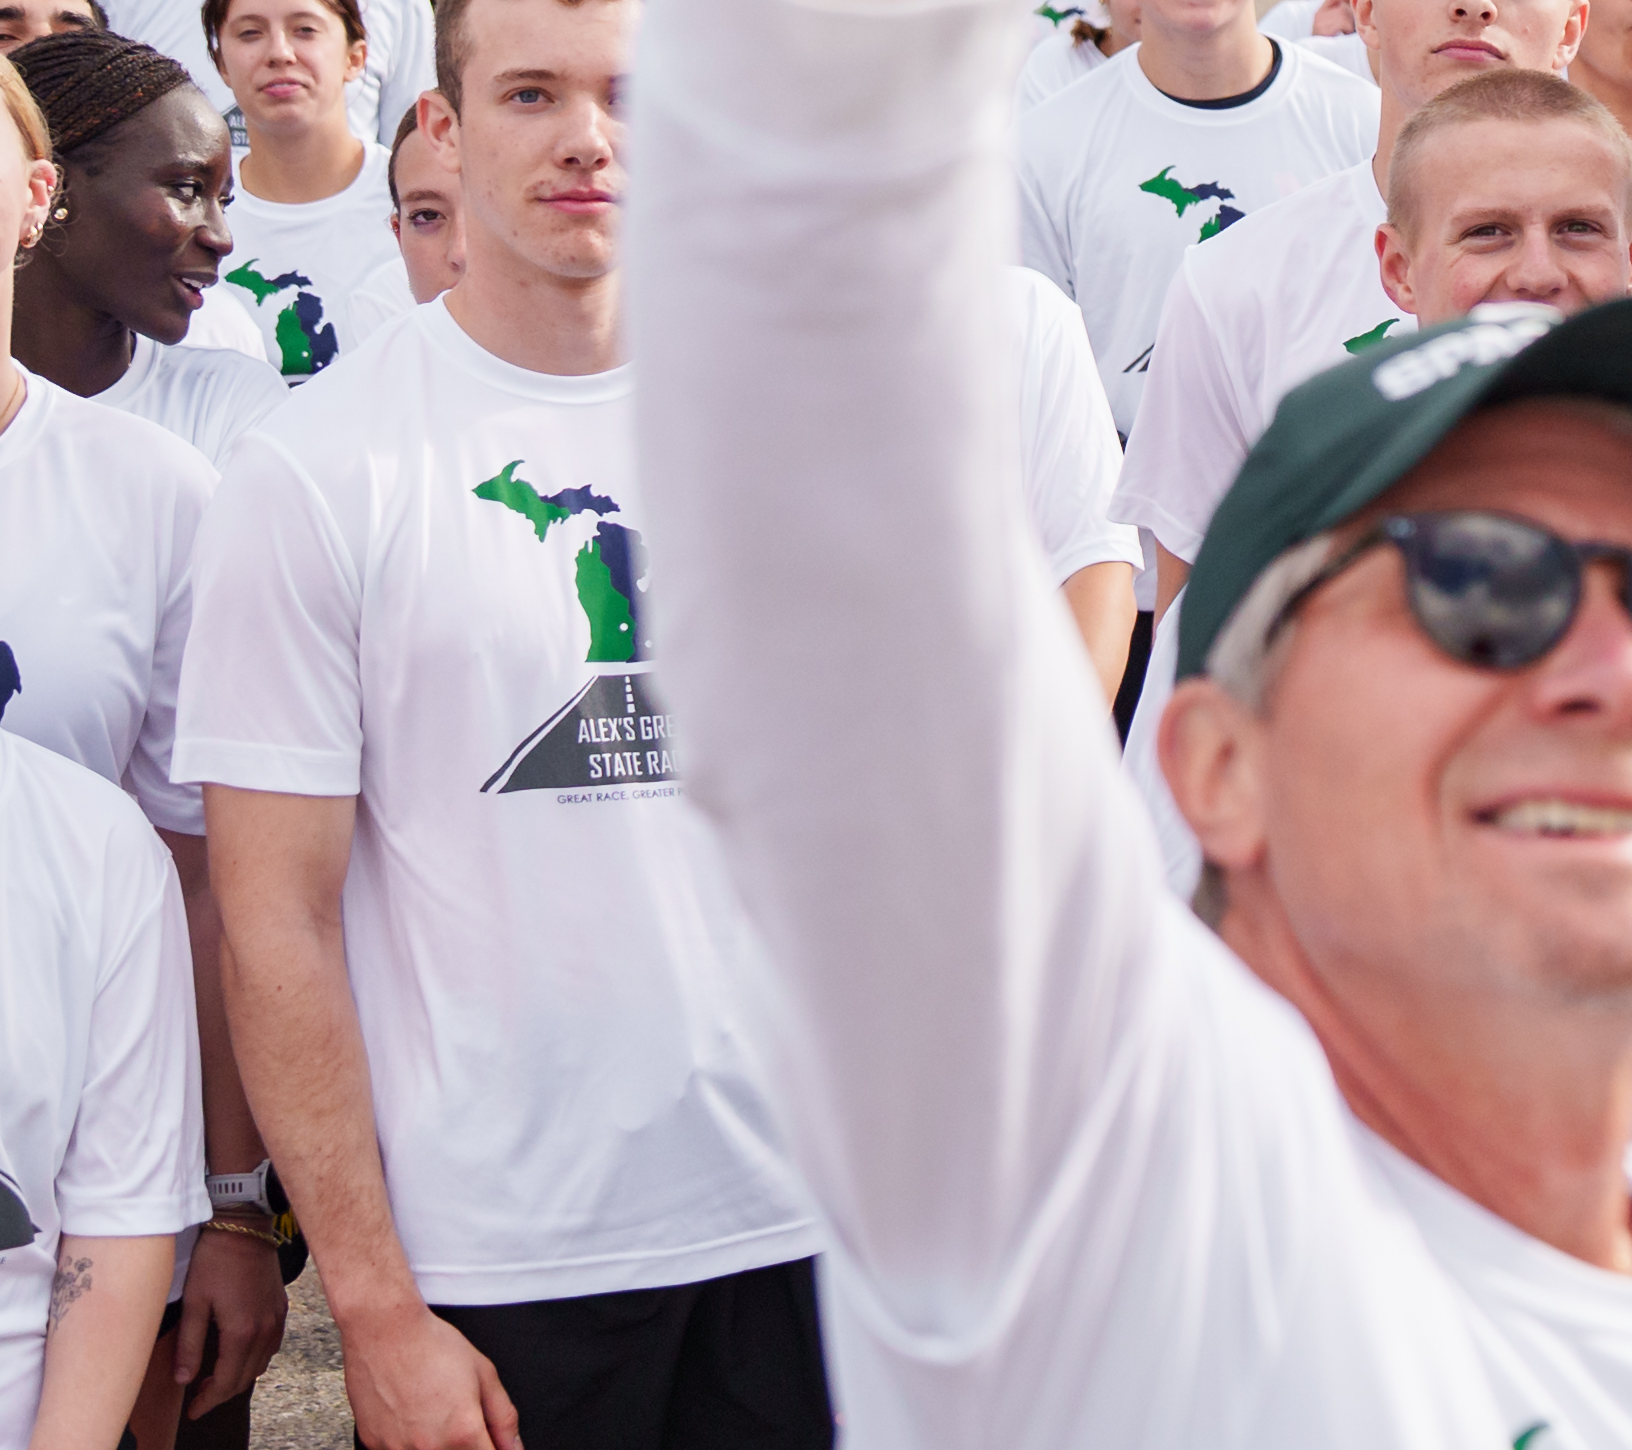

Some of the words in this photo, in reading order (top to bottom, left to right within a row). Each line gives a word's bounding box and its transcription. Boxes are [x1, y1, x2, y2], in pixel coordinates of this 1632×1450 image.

[578, 717, 636, 743] ALEX'S
[639, 715, 676, 740] GRE
[589, 752, 643, 778] STATE
[646, 750, 679, 775] RAC
[557, 794, 592, 804] GREAT
[632, 787, 675, 799] GREATER
